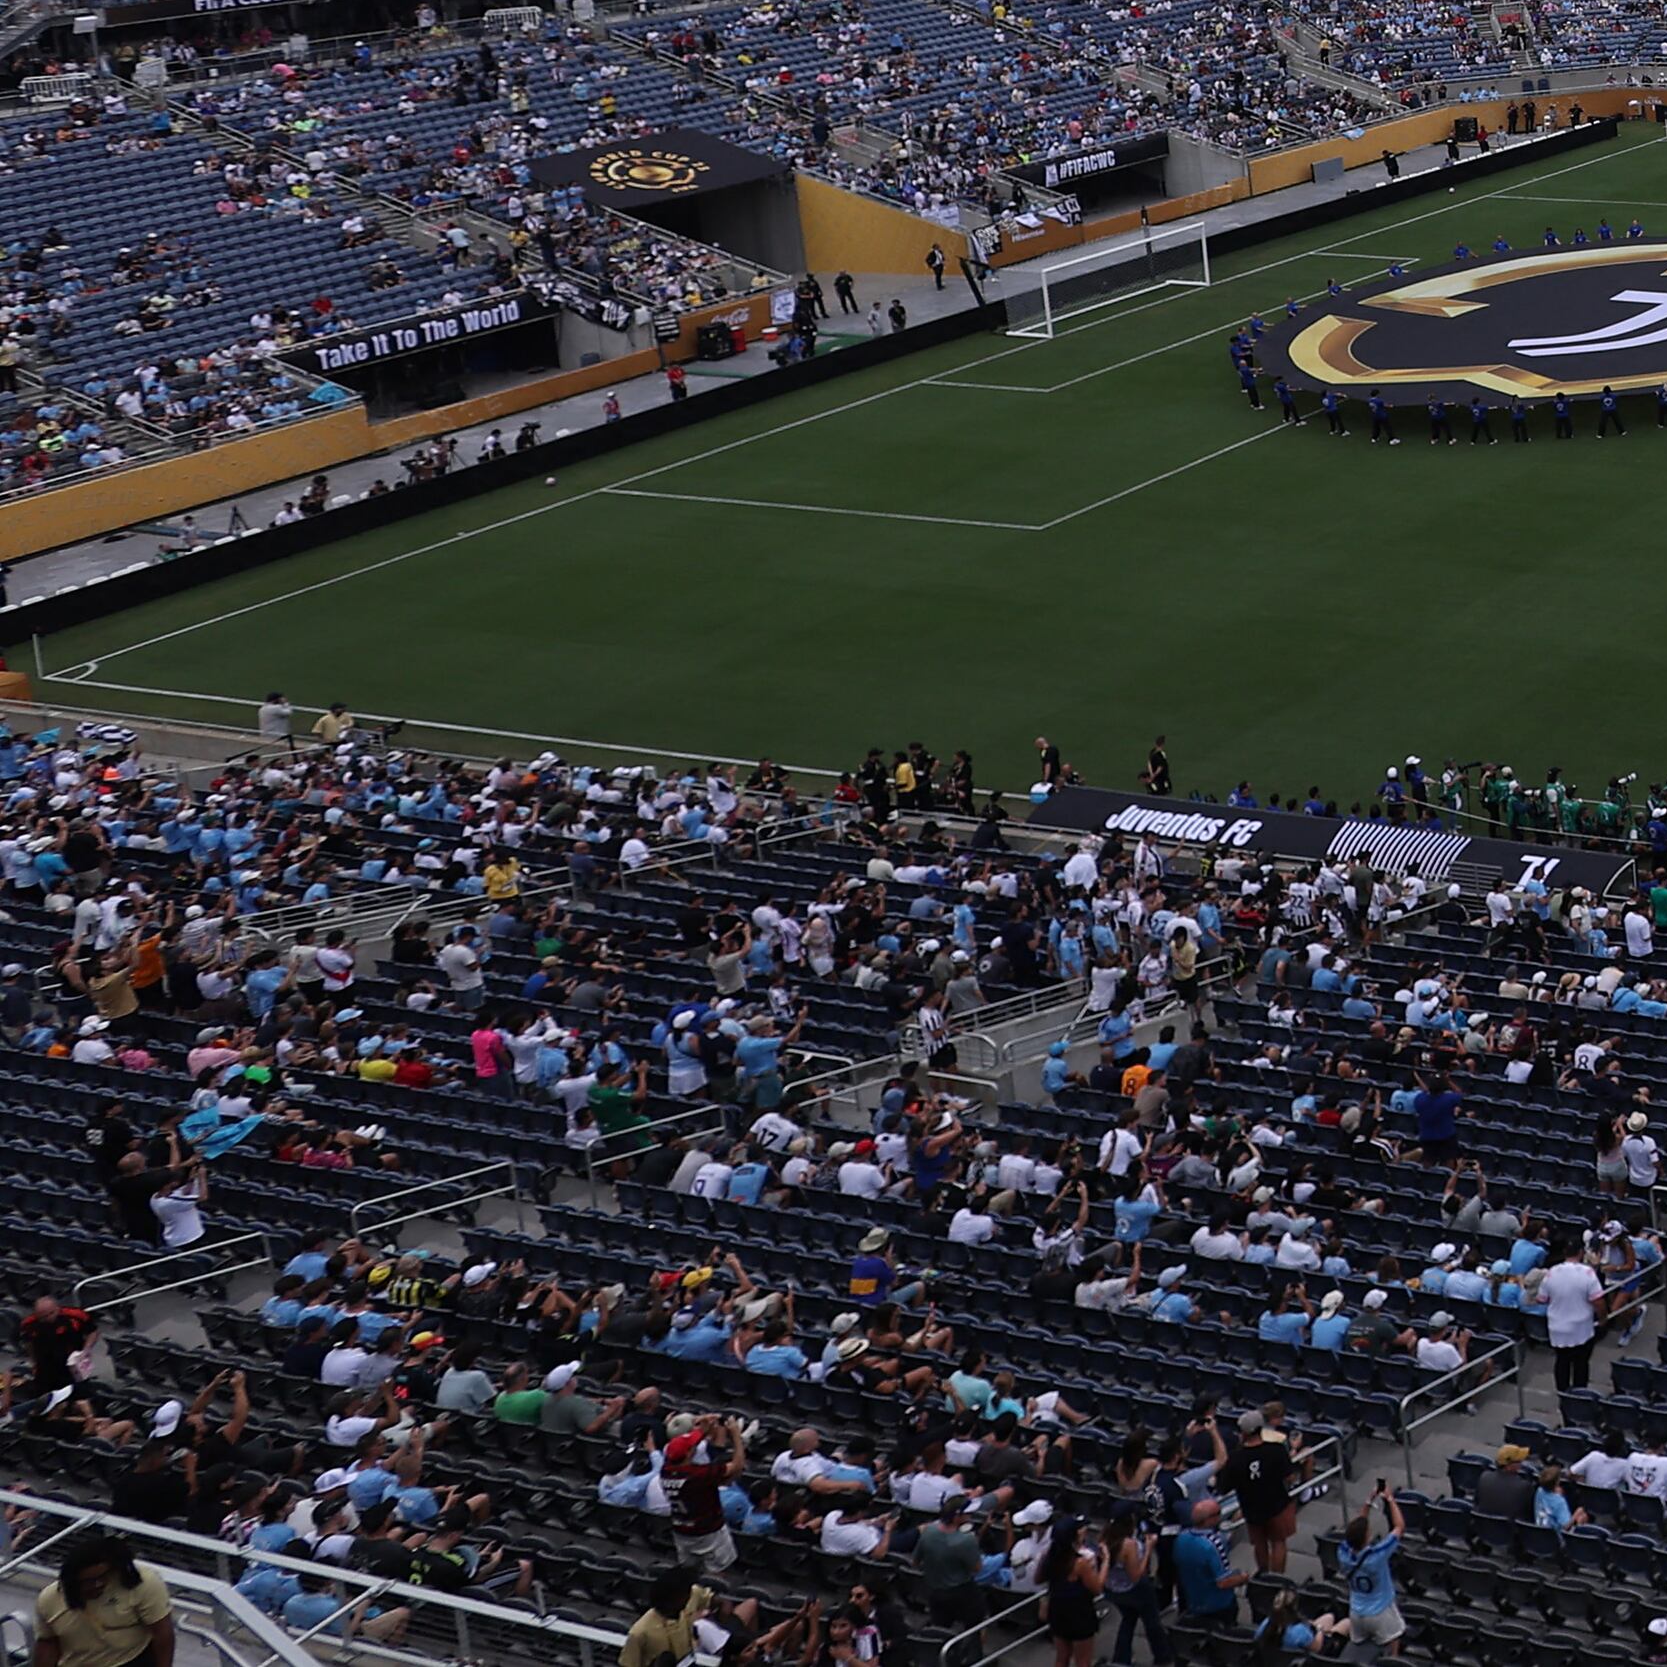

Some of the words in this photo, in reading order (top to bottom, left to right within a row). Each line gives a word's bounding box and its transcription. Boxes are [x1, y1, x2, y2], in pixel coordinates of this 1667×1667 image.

[1059, 150, 1116, 180] #FIFACWC
[315, 342, 368, 371] Take
[370, 336, 390, 359] It
[392, 332, 418, 354] To
[420, 315, 458, 347] The
[460, 300, 520, 336] World
[1105, 804, 1225, 842] Juventus
[1220, 819, 1263, 846] FC
[1578, 1054, 1589, 1070] 8
[1126, 1077, 1136, 1094] 8
[756, 1128, 780, 1147] 17
